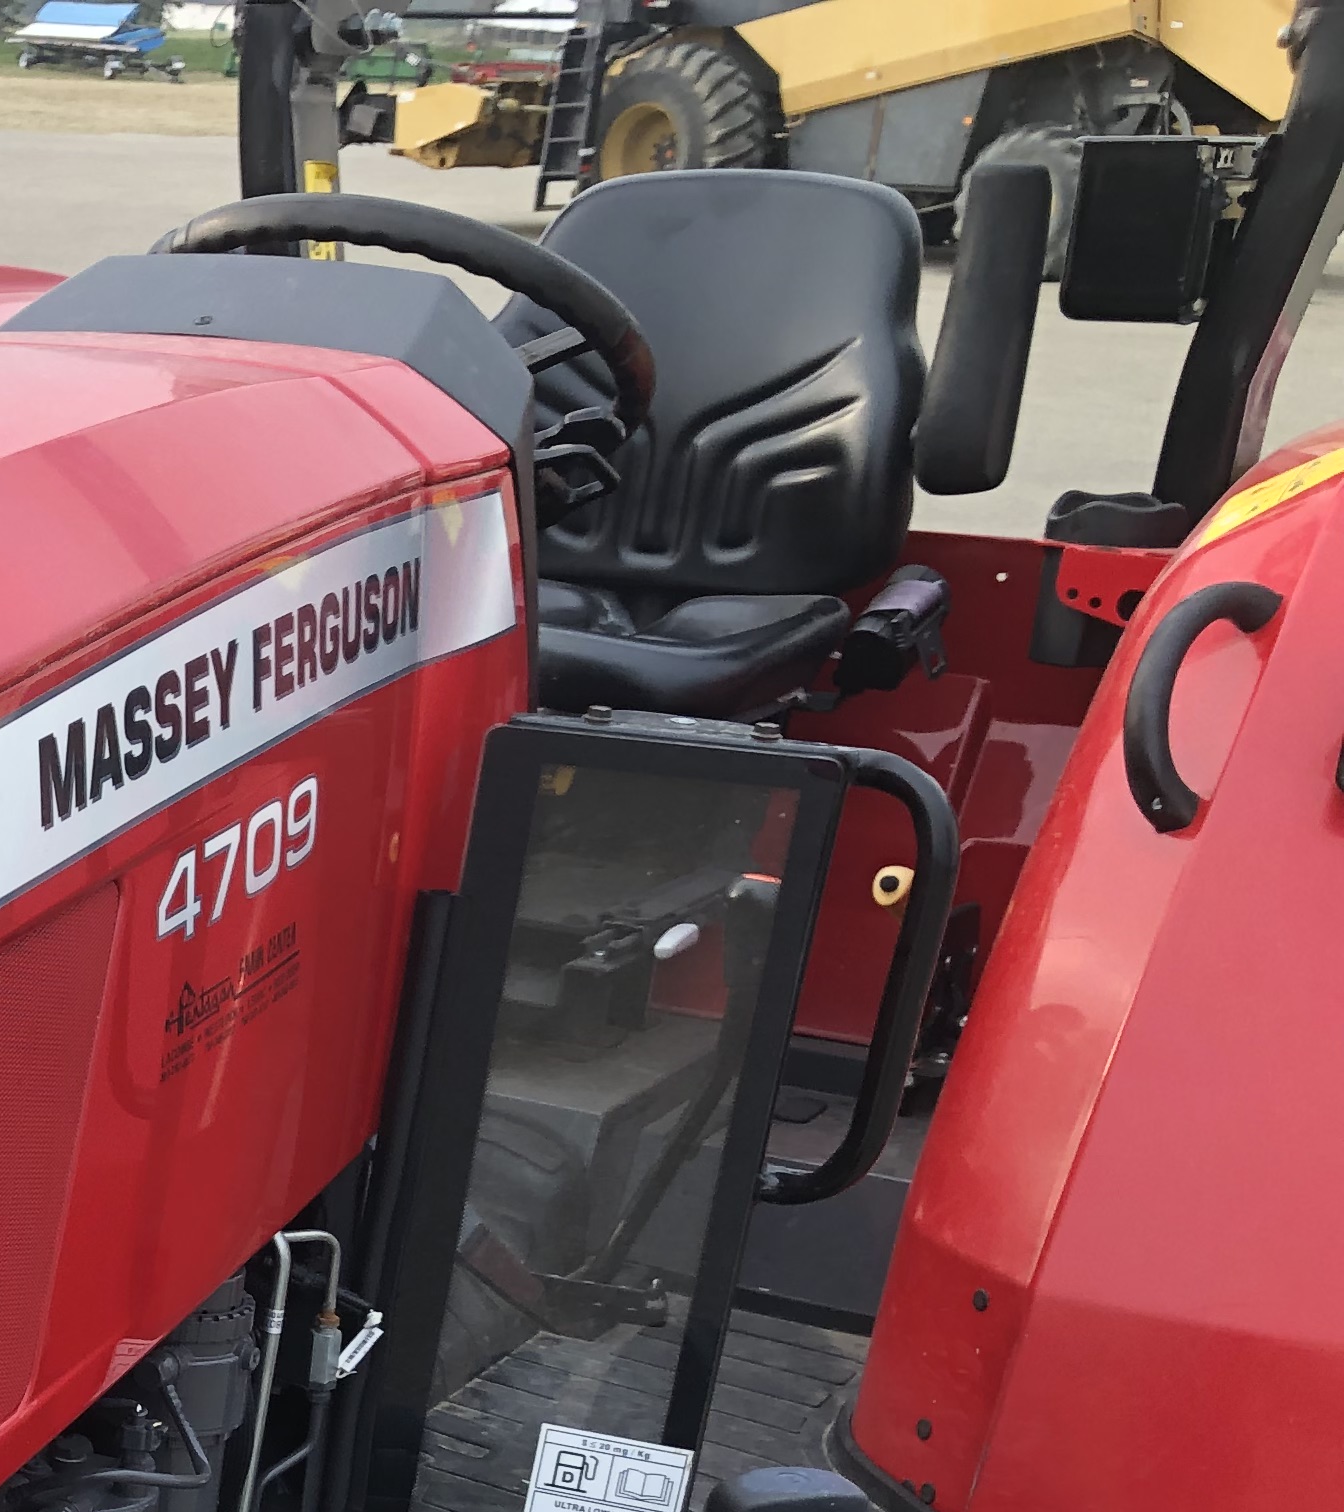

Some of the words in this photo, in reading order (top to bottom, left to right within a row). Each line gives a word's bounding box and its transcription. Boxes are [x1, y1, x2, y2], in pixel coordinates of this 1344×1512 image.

[38, 638, 239, 831] MASSEY
[252, 557, 421, 712] FERGUSON
[155, 774, 318, 941] 4709
[554, 1500, 585, 1512] ULTRA
[562, 1471, 574, 1483] D
